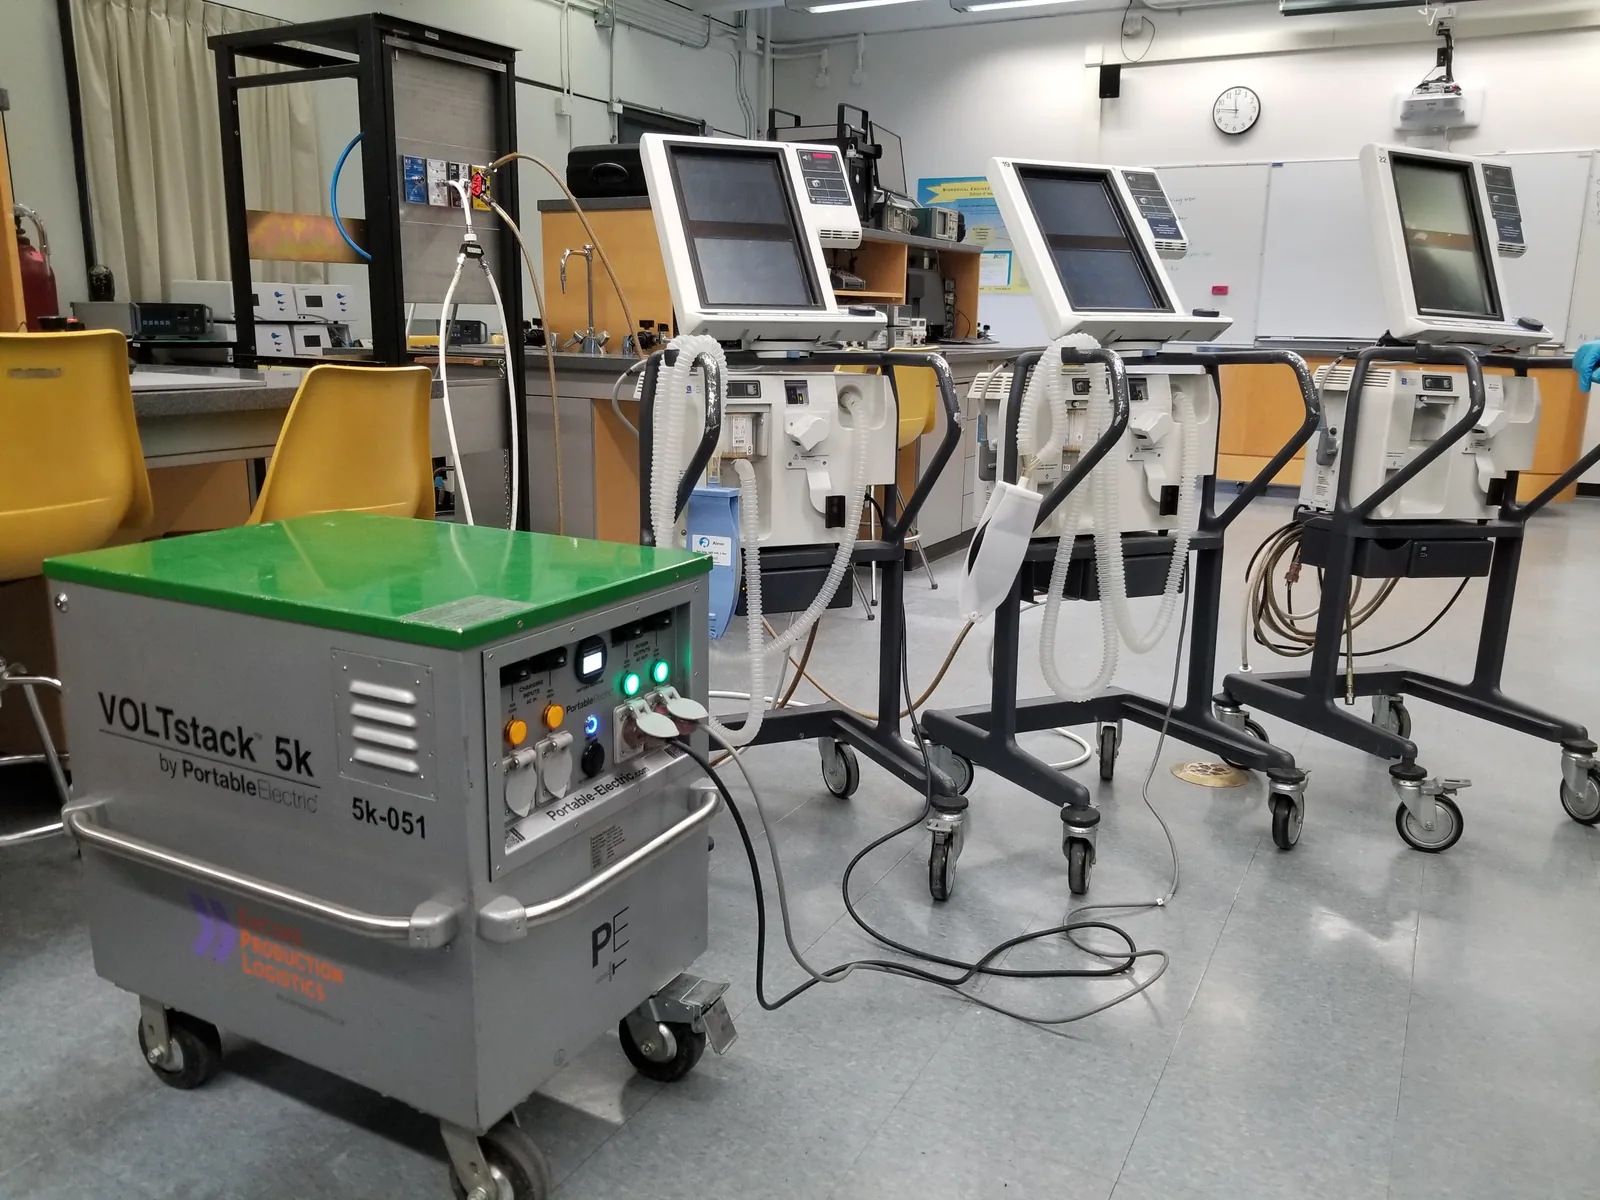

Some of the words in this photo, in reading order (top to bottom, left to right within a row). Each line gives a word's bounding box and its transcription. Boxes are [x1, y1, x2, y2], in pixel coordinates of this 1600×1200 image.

[472, 175, 480, 194] AIR
[747, 445, 752, 454] 8
[275, 735, 315, 777] 5k
[158, 752, 178, 779] by
[181, 758, 319, 814] PortableElectric
[546, 766, 651, 821] Portable-Electric.com
[352, 796, 425, 839] 5k-051
[240, 929, 344, 985] PRODUCTION
[241, 953, 326, 1001] LOGISTICS
